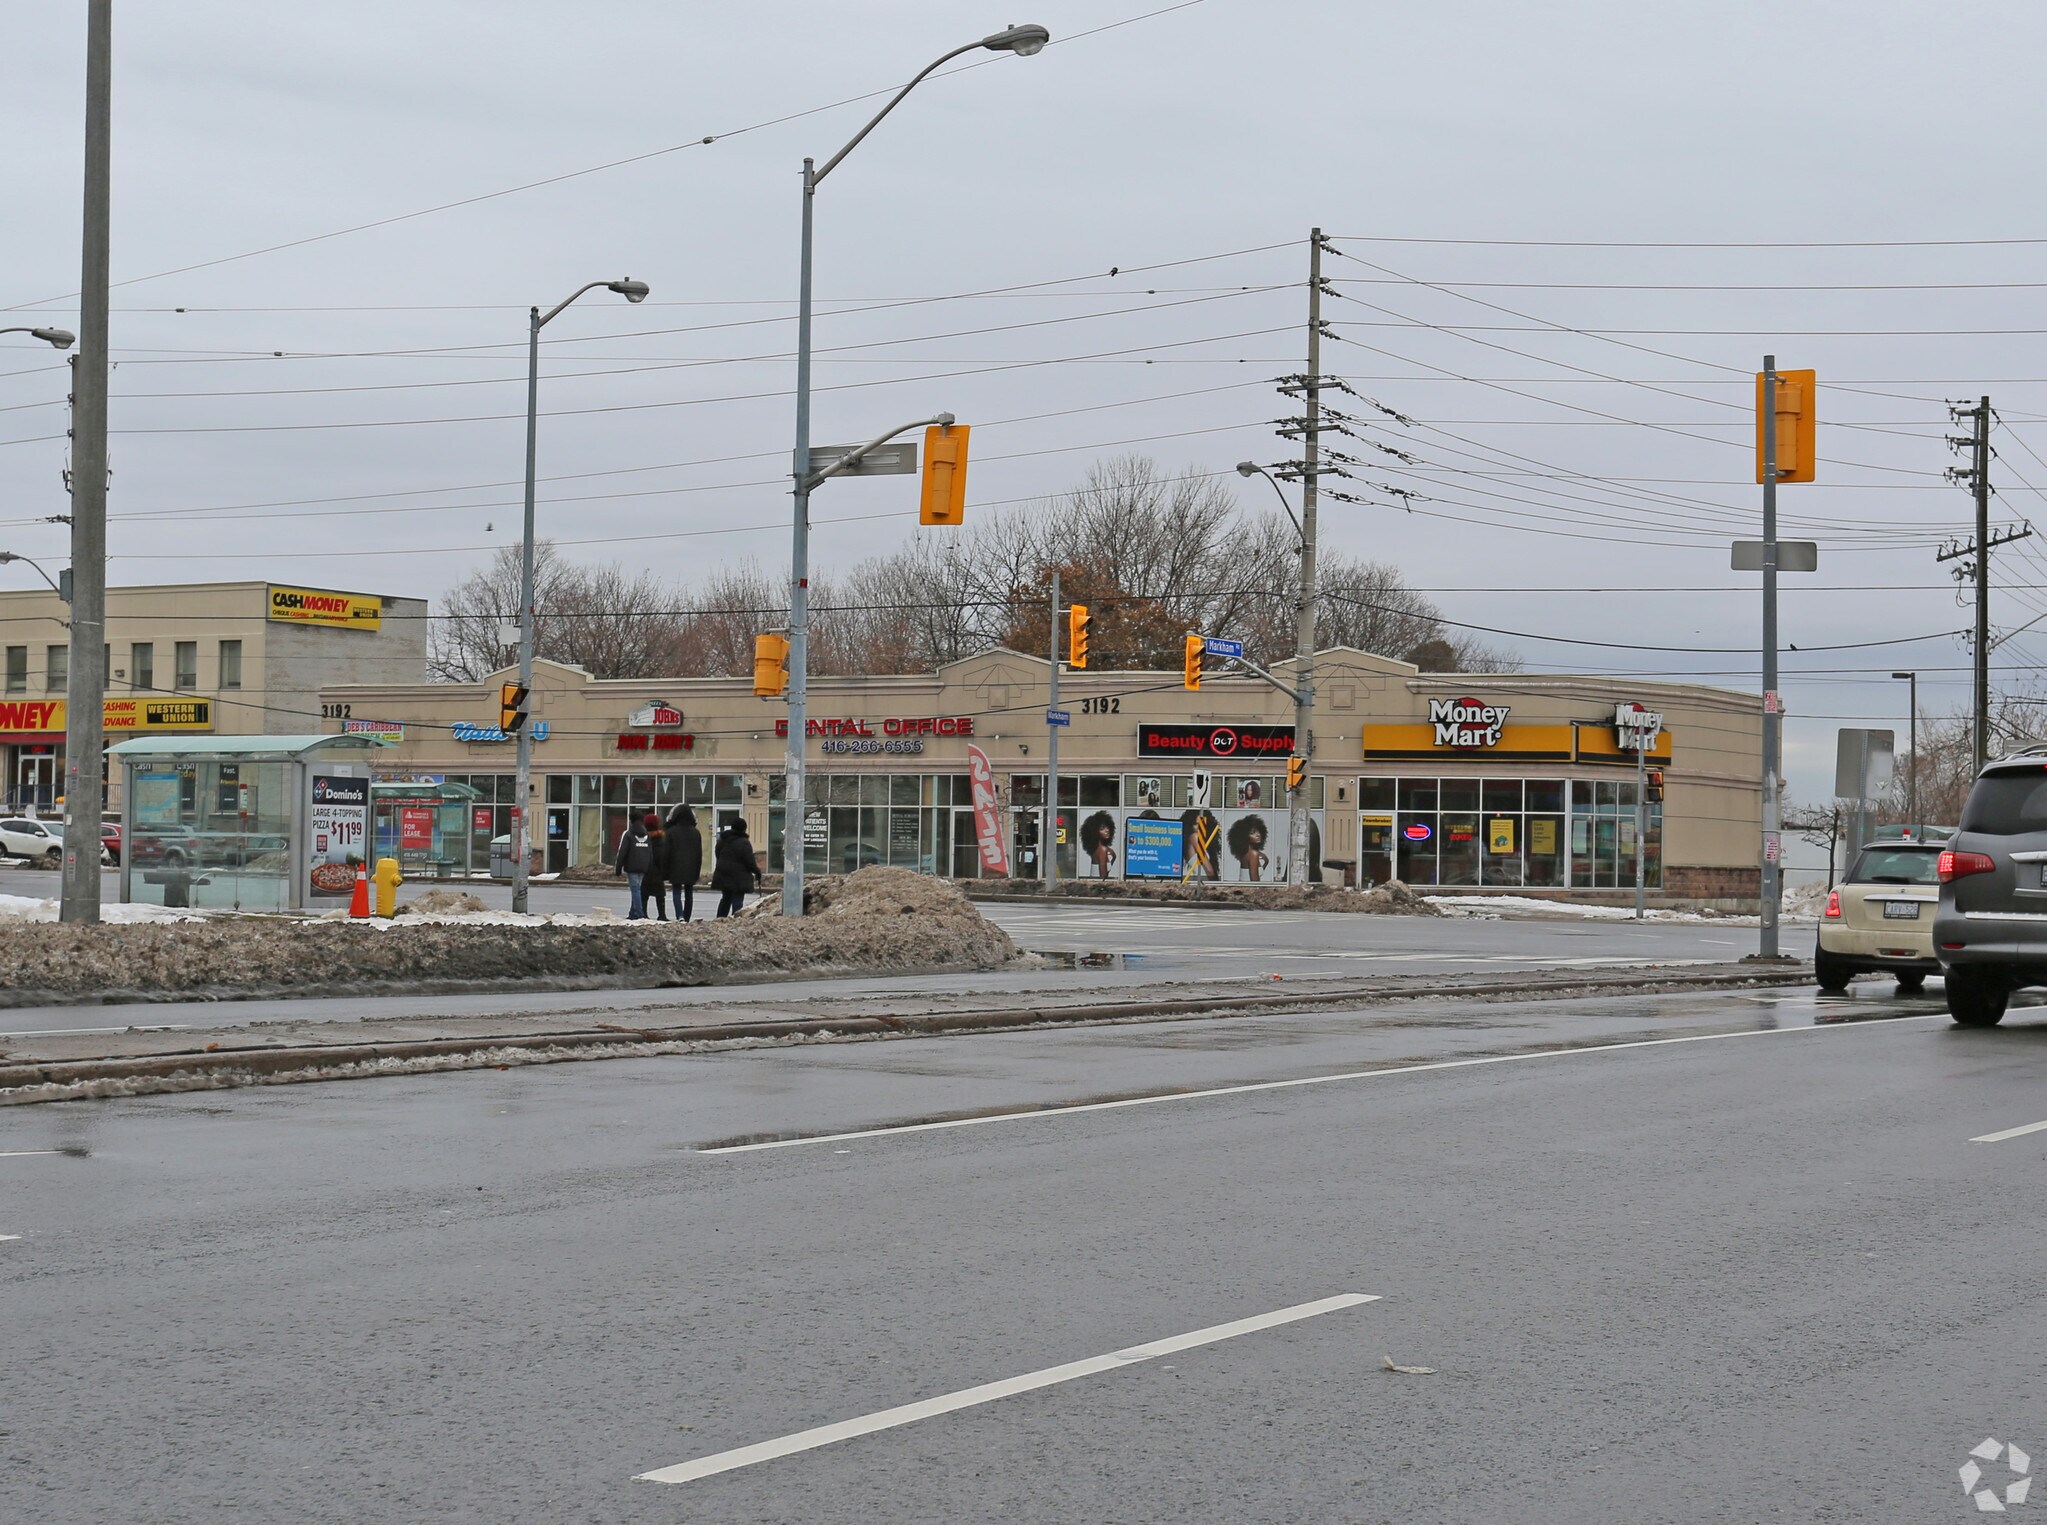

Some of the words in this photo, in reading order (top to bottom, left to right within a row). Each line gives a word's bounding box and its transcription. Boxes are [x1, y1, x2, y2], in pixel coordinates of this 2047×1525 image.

[1209, 640, 1235, 653] Markham
[147, 705, 195, 714] WESTERN
[321, 704, 351, 718] 3192
[1082, 697, 1120, 714] 3192
[103, 717, 136, 727] DVANCE
[162, 713, 195, 722] UNION
[1429, 700, 1511, 730] Money
[1615, 704, 1664, 736] Money
[346, 722, 365, 732] DEB'S
[533, 720, 550, 741] U
[775, 718, 875, 737] DNTAL
[883, 718, 974, 736] OFFICE
[1433, 723, 1497, 746] Mart
[1618, 726, 1657, 751] Mart
[617, 734, 648, 750] PAPA
[651, 734, 696, 751] JOHN'S
[821, 740, 924, 754] 416-266-6555
[1148, 734, 1206, 750] Beauty
[1241, 734, 1296, 752] Supply
[325, 789, 363, 801] Domino's
[313, 808, 331, 817] LARGE
[332, 808, 363, 818] 4-TOPPING
[313, 820, 330, 829] PIZZA
[1128, 823, 1144, 833] Small
[1144, 824, 1167, 834] business
[1167, 825, 1183, 835] loans
